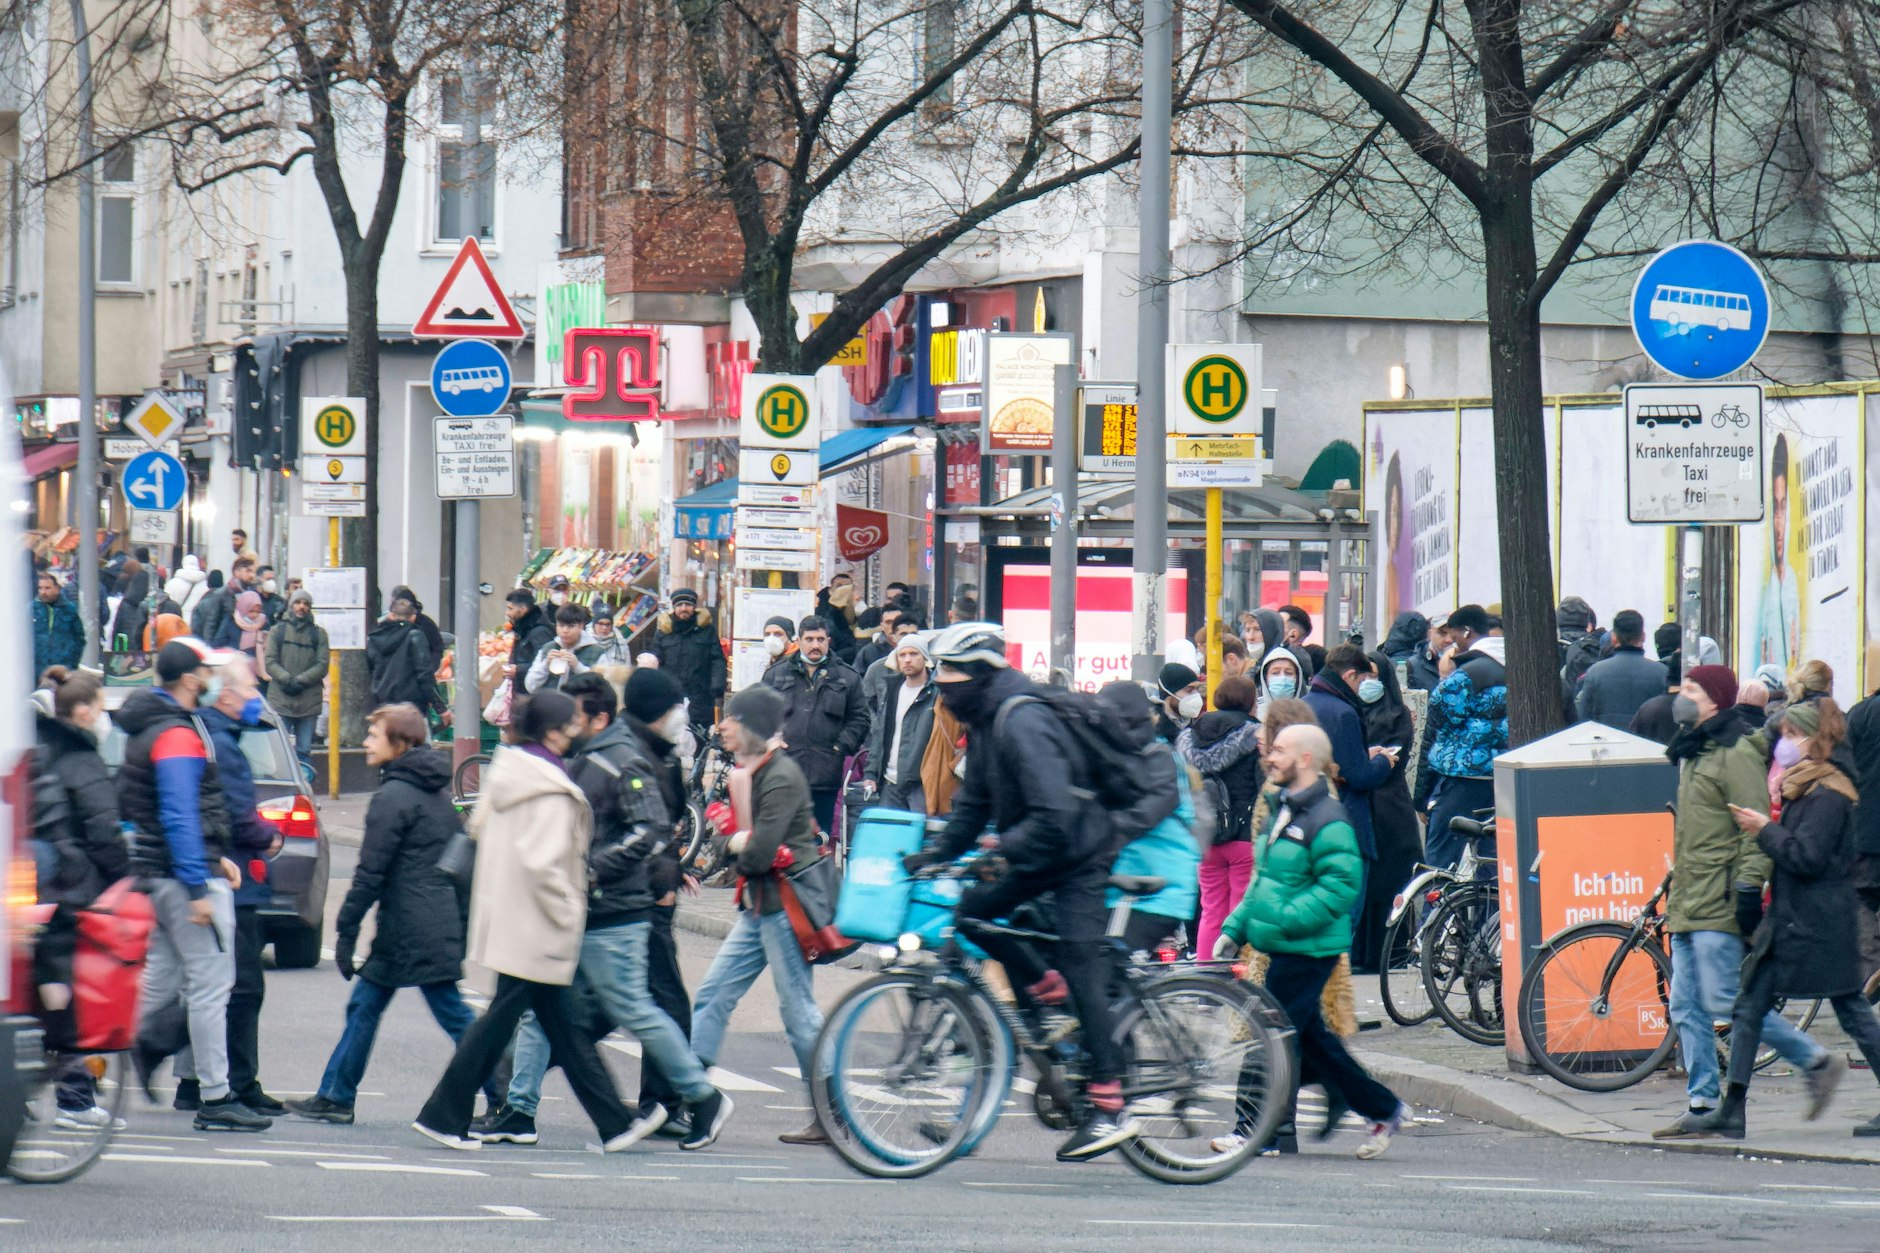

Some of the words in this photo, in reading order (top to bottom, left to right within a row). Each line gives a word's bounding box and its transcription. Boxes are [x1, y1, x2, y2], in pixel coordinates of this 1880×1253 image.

[1202, 372, 1231, 407] H
[1105, 394, 1126, 402] Linie
[771, 397, 795, 427] H
[326, 416, 346, 438] H
[441, 432, 506, 442] Krankenfahrzeuge
[453, 441, 475, 450] TAXI
[479, 441, 496, 450] frei
[1635, 442, 1754, 462] Krankenfahrzeuge
[777, 459, 785, 470] 6
[1103, 459, 1109, 467] U
[457, 465, 470, 473] und
[472, 465, 509, 477] Aussteigen
[1183, 470, 1200, 478] N94
[1683, 464, 1708, 481] Taxi
[467, 486, 485, 494] frei
[1684, 487, 1707, 503] frei
[1573, 872, 1606, 897] Ich
[1611, 871, 1643, 895] bin
[1565, 906, 1604, 926] neu
